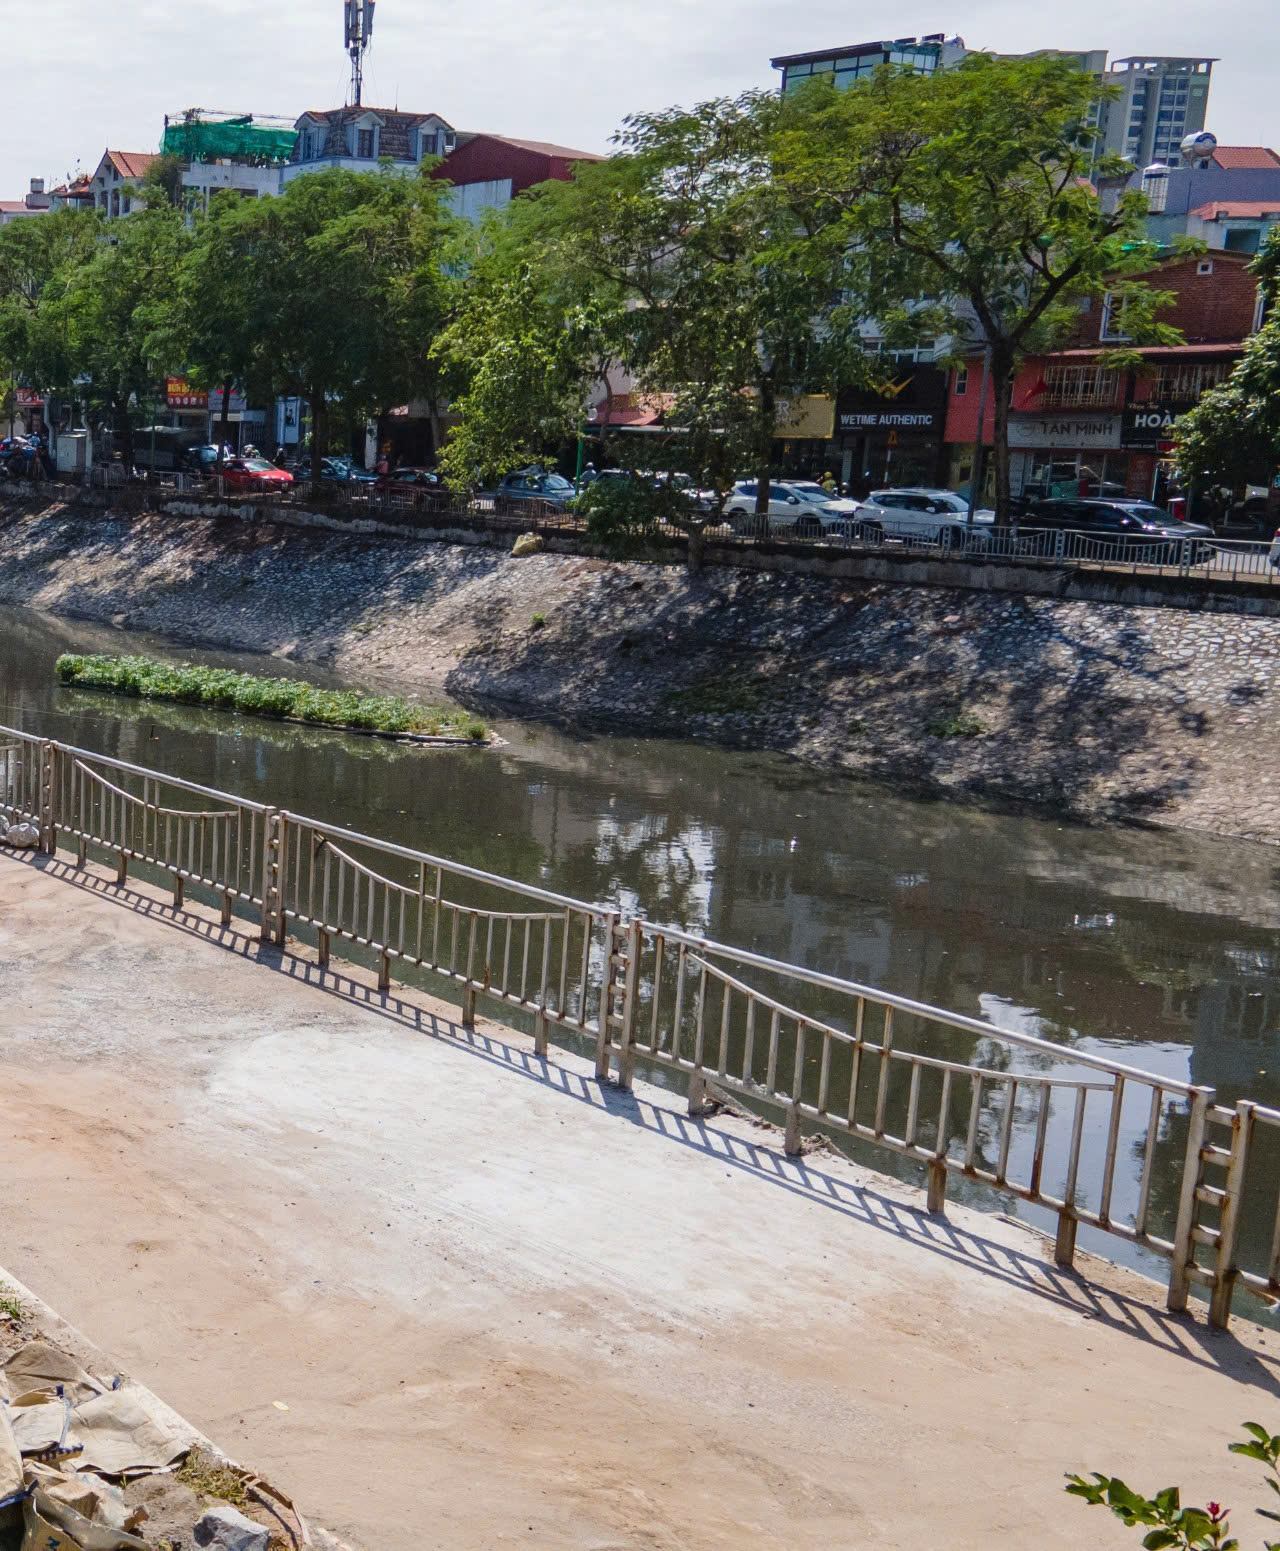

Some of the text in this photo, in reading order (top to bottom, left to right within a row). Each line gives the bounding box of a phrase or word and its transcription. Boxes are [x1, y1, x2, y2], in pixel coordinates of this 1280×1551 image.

[841, 414, 933, 425] WETIME AUTHENTIC
[1075, 422, 1113, 436] MINH
